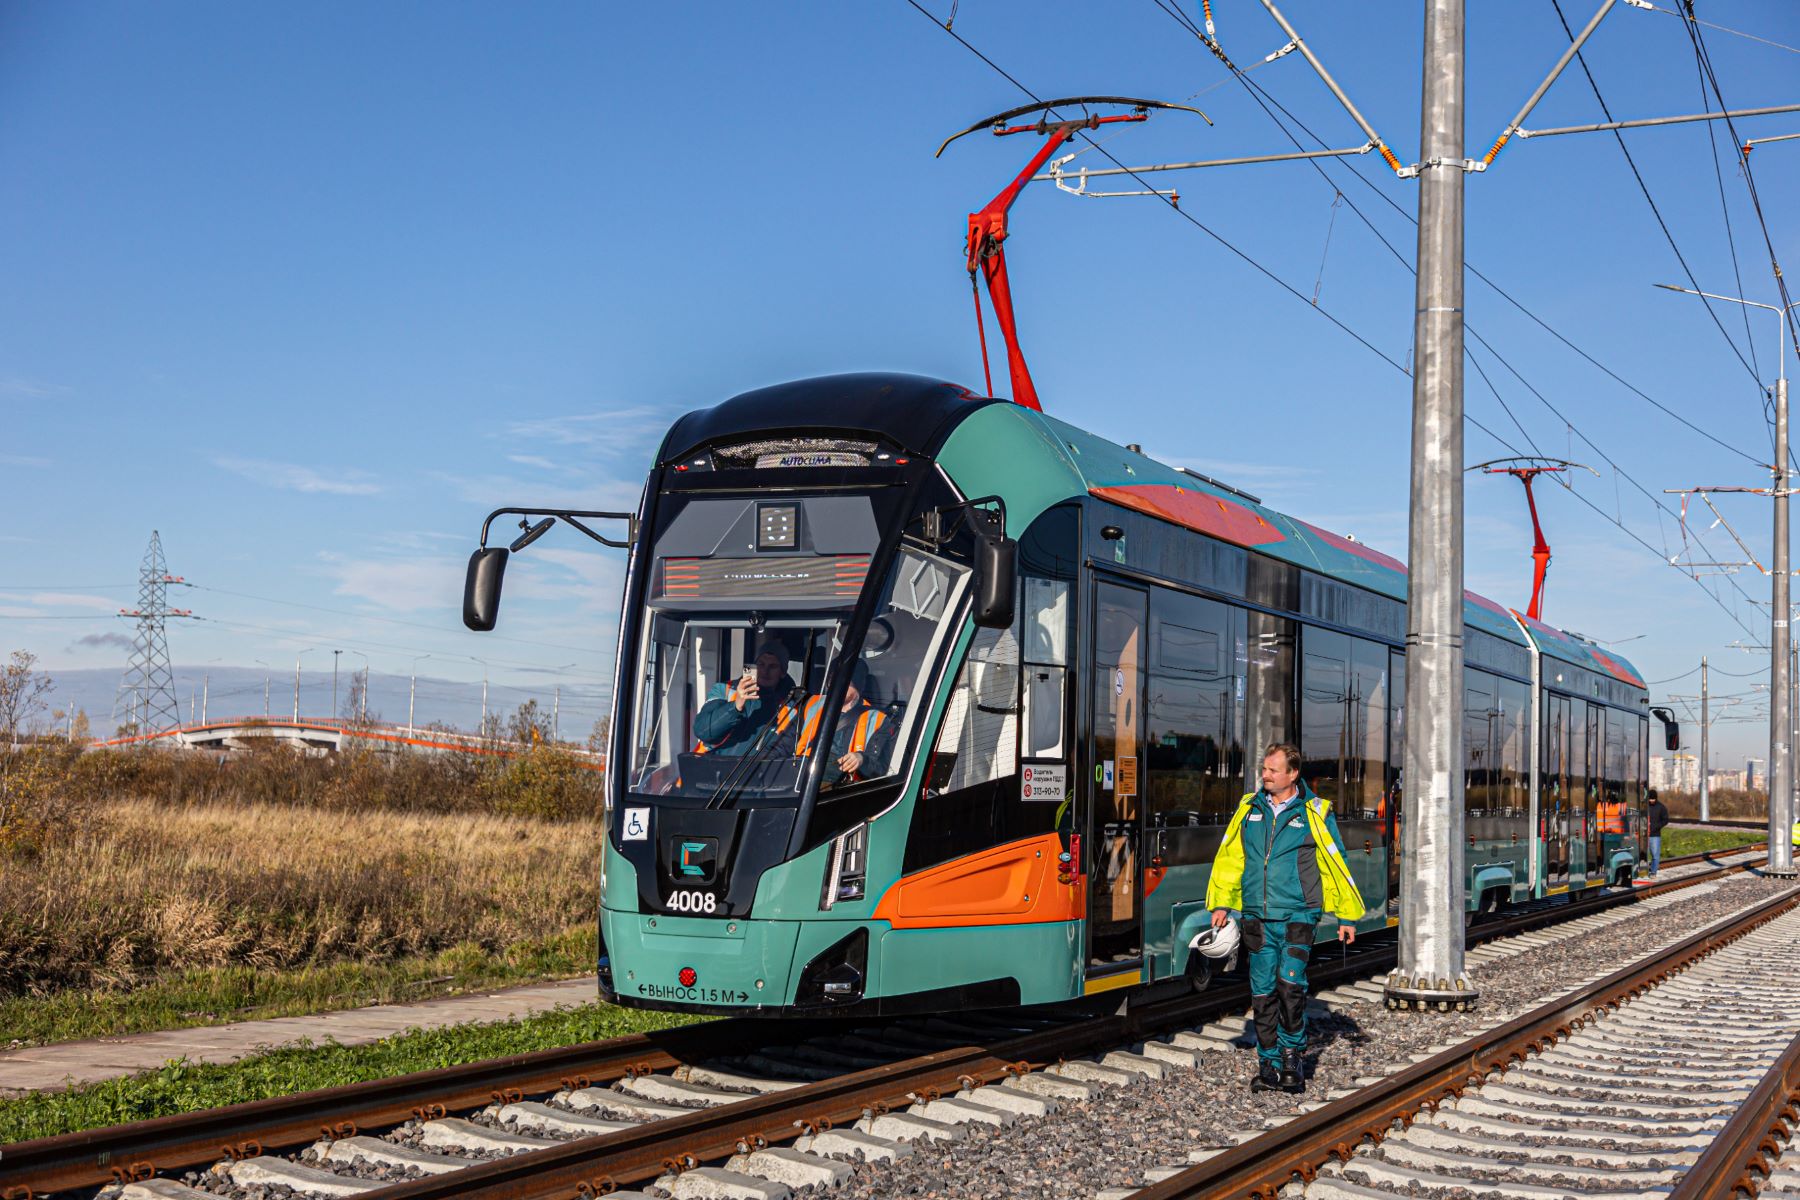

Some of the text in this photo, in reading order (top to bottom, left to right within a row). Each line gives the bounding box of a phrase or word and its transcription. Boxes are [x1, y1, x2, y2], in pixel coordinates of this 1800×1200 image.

[666, 890, 716, 914] 4008
[648, 984, 735, 1003] ВЫНОС 1.5 М
